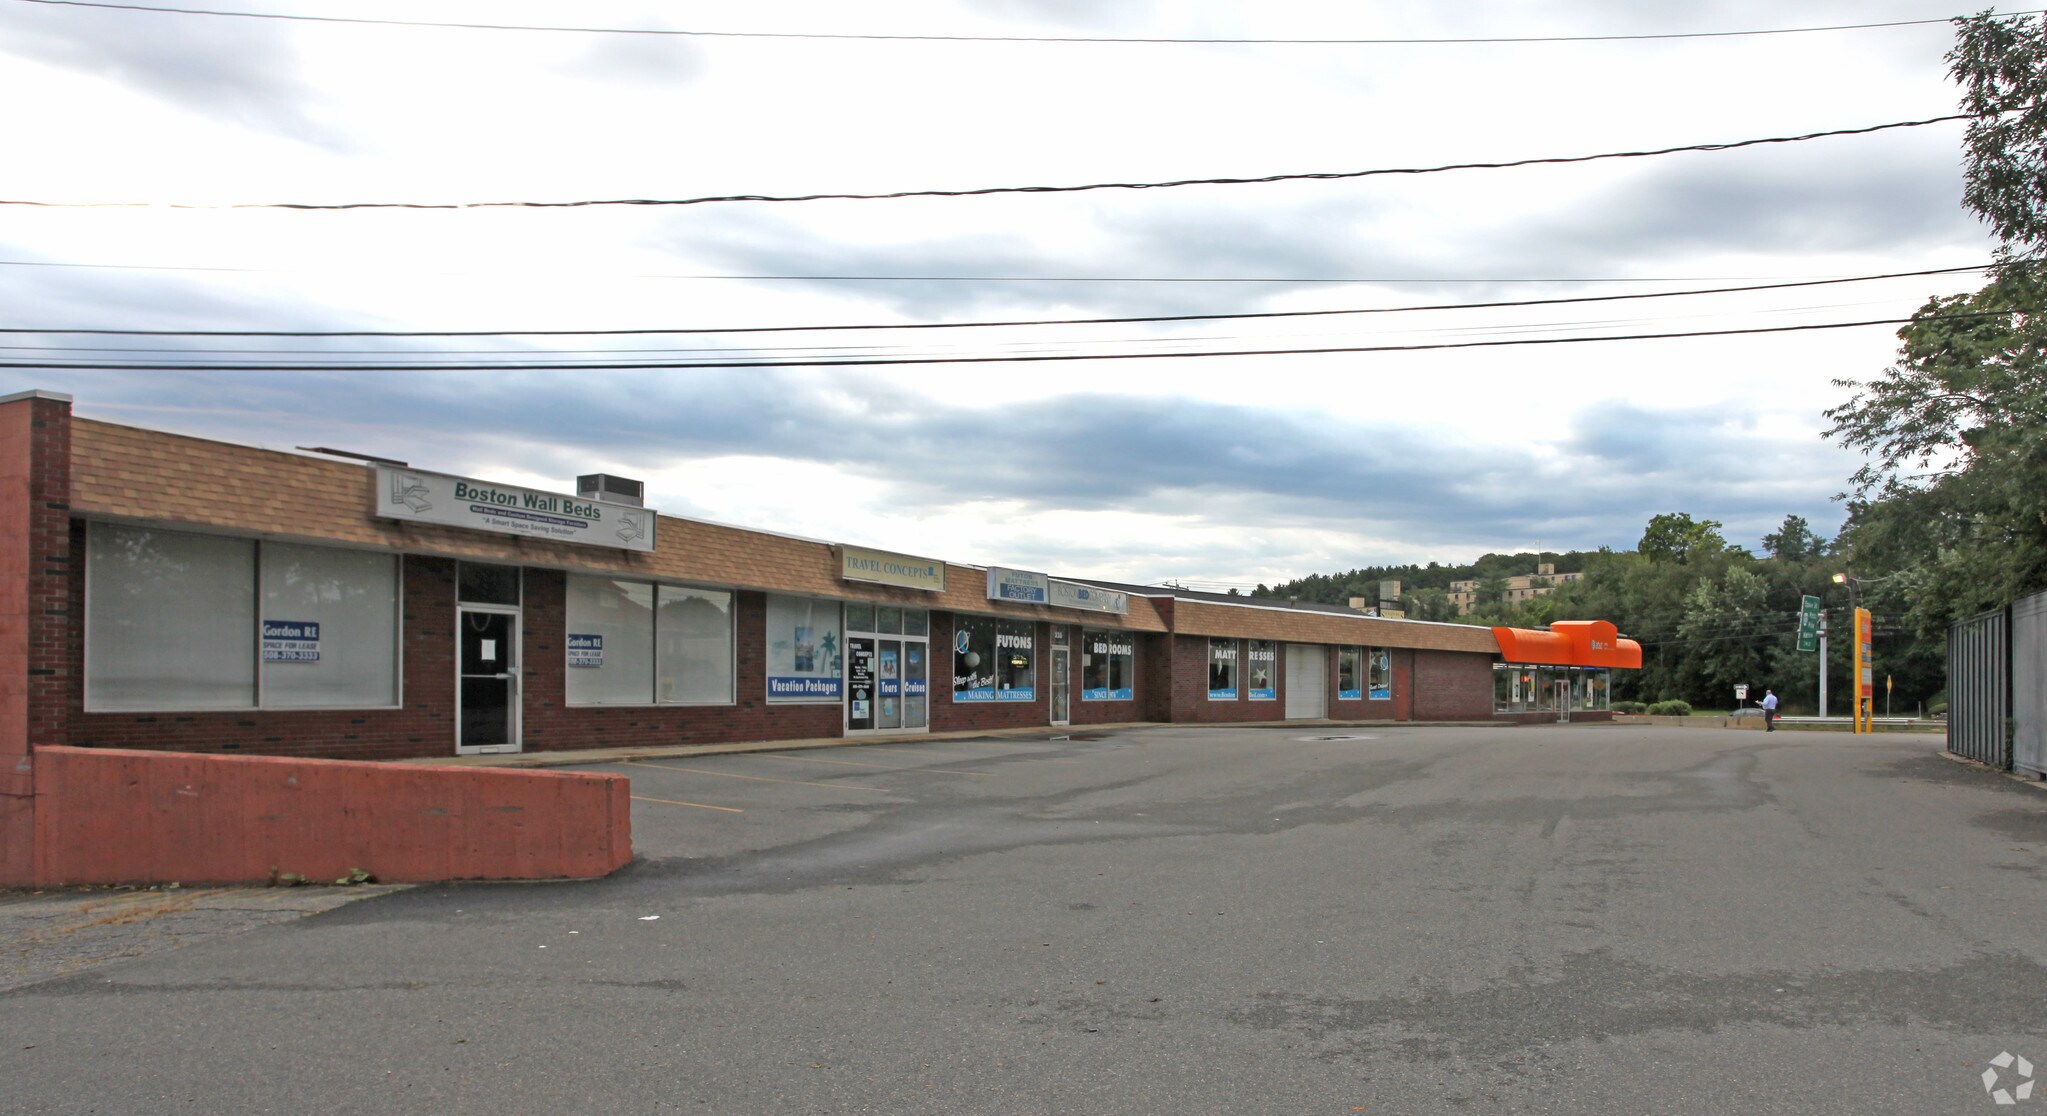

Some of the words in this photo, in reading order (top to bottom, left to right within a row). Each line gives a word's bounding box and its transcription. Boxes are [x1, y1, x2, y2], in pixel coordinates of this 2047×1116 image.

[455, 482, 517, 506] Boston
[523, 493, 558, 512] Wall
[563, 499, 601, 519] Beds
[491, 518, 510, 527] Smart
[511, 521, 529, 530] Space
[530, 524, 550, 534] Saving
[846, 556, 882, 573] TRAVEL
[883, 562, 928, 579] CONCEPTS
[1004, 577, 1039, 586] MATTRESS
[1011, 571, 1033, 580] FUTON
[1006, 584, 1037, 594] FACTORY
[1008, 591, 1036, 601] OUTLET
[263, 624, 301, 638] Gordon
[304, 626, 318, 638] RE
[284, 642, 297, 650] FOR
[298, 642, 318, 650] LEASE
[568, 637, 592, 647] Gordon
[592, 638, 601, 647] RE
[996, 634, 1033, 650] FUTONS
[1093, 642, 1108, 654] BED
[1214, 649, 1237, 660] MATT
[771, 679, 804, 692] Vacation
[805, 679, 837, 695] Packages
[880, 681, 898, 693] Tours
[904, 681, 926, 693] Cruises
[953, 675, 967, 687] Sleep
[967, 690, 995, 700] MAKING
[997, 690, 1033, 700] MATTRESSES
